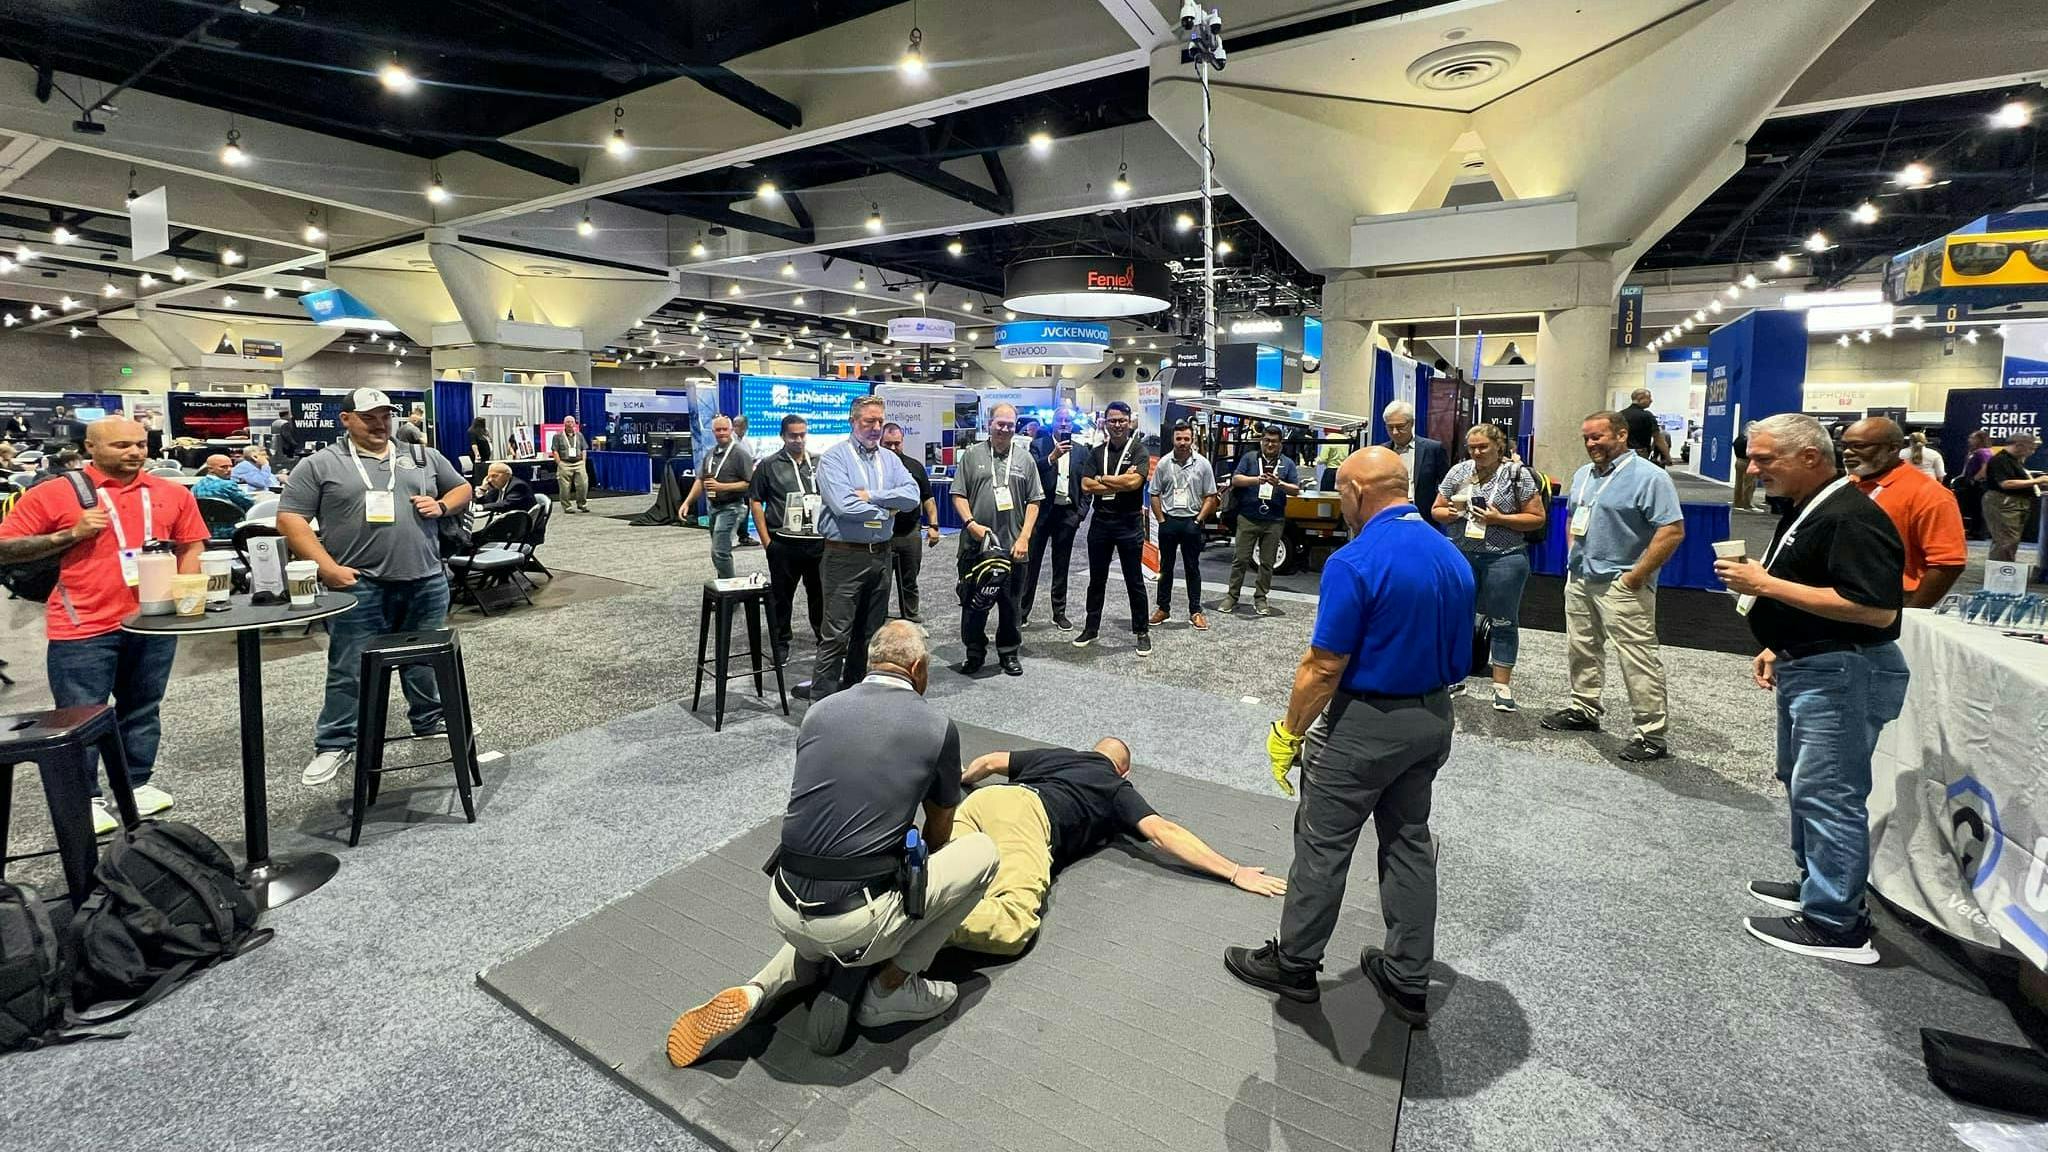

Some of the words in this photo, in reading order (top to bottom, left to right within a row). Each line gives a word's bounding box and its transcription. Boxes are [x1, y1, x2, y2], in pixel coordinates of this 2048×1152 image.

[1625, 299, 1633, 345] 1300
[1041, 326, 1108, 341] JVCKENWOOD
[301, 402, 322, 411] MOST
[304, 412, 320, 420] ARE
[1981, 412, 2038, 425] SECRET
[295, 420, 317, 428] WHAT
[319, 420, 335, 428] ARE
[623, 433, 641, 445] SAVE
